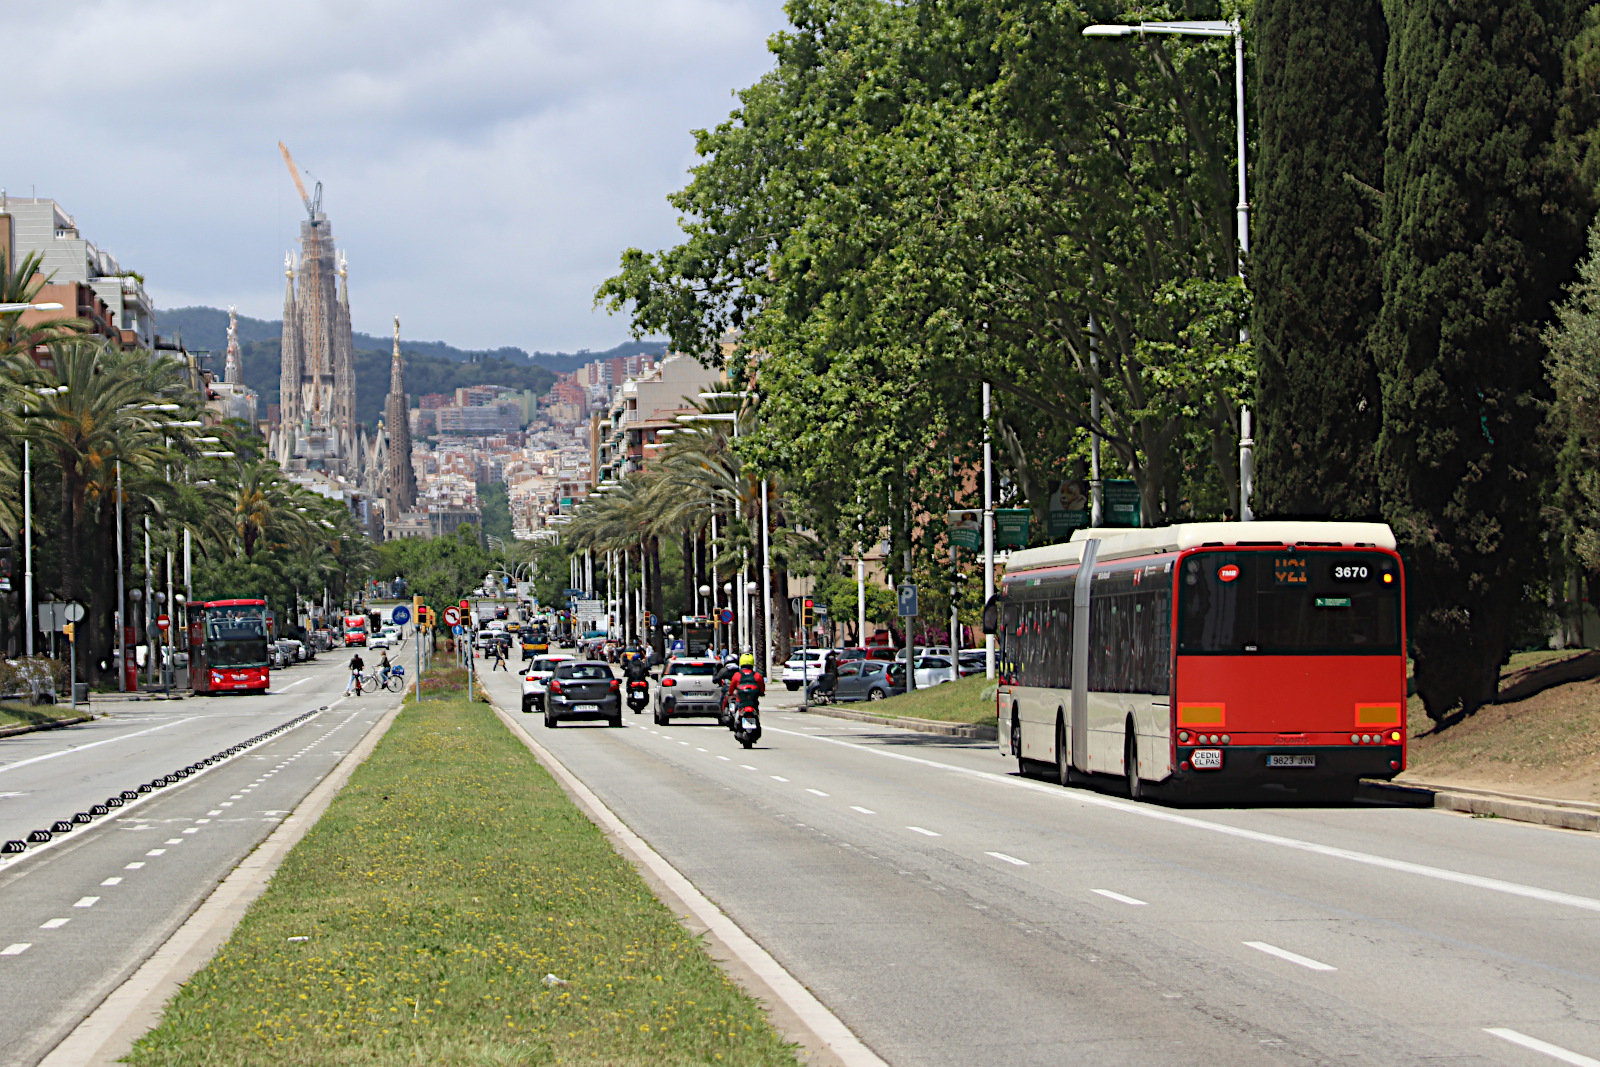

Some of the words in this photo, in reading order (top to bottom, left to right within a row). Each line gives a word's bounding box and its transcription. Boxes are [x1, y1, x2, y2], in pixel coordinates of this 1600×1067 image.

[1335, 567, 1368, 578] 3670
[901, 587, 914, 604] P
[1273, 736, 1309, 744] SOLARIS
[1194, 751, 1220, 759] CEDIU
[1205, 758, 1220, 766] PAS
[1273, 756, 1294, 765] 9823
[1298, 756, 1314, 765] JVN
